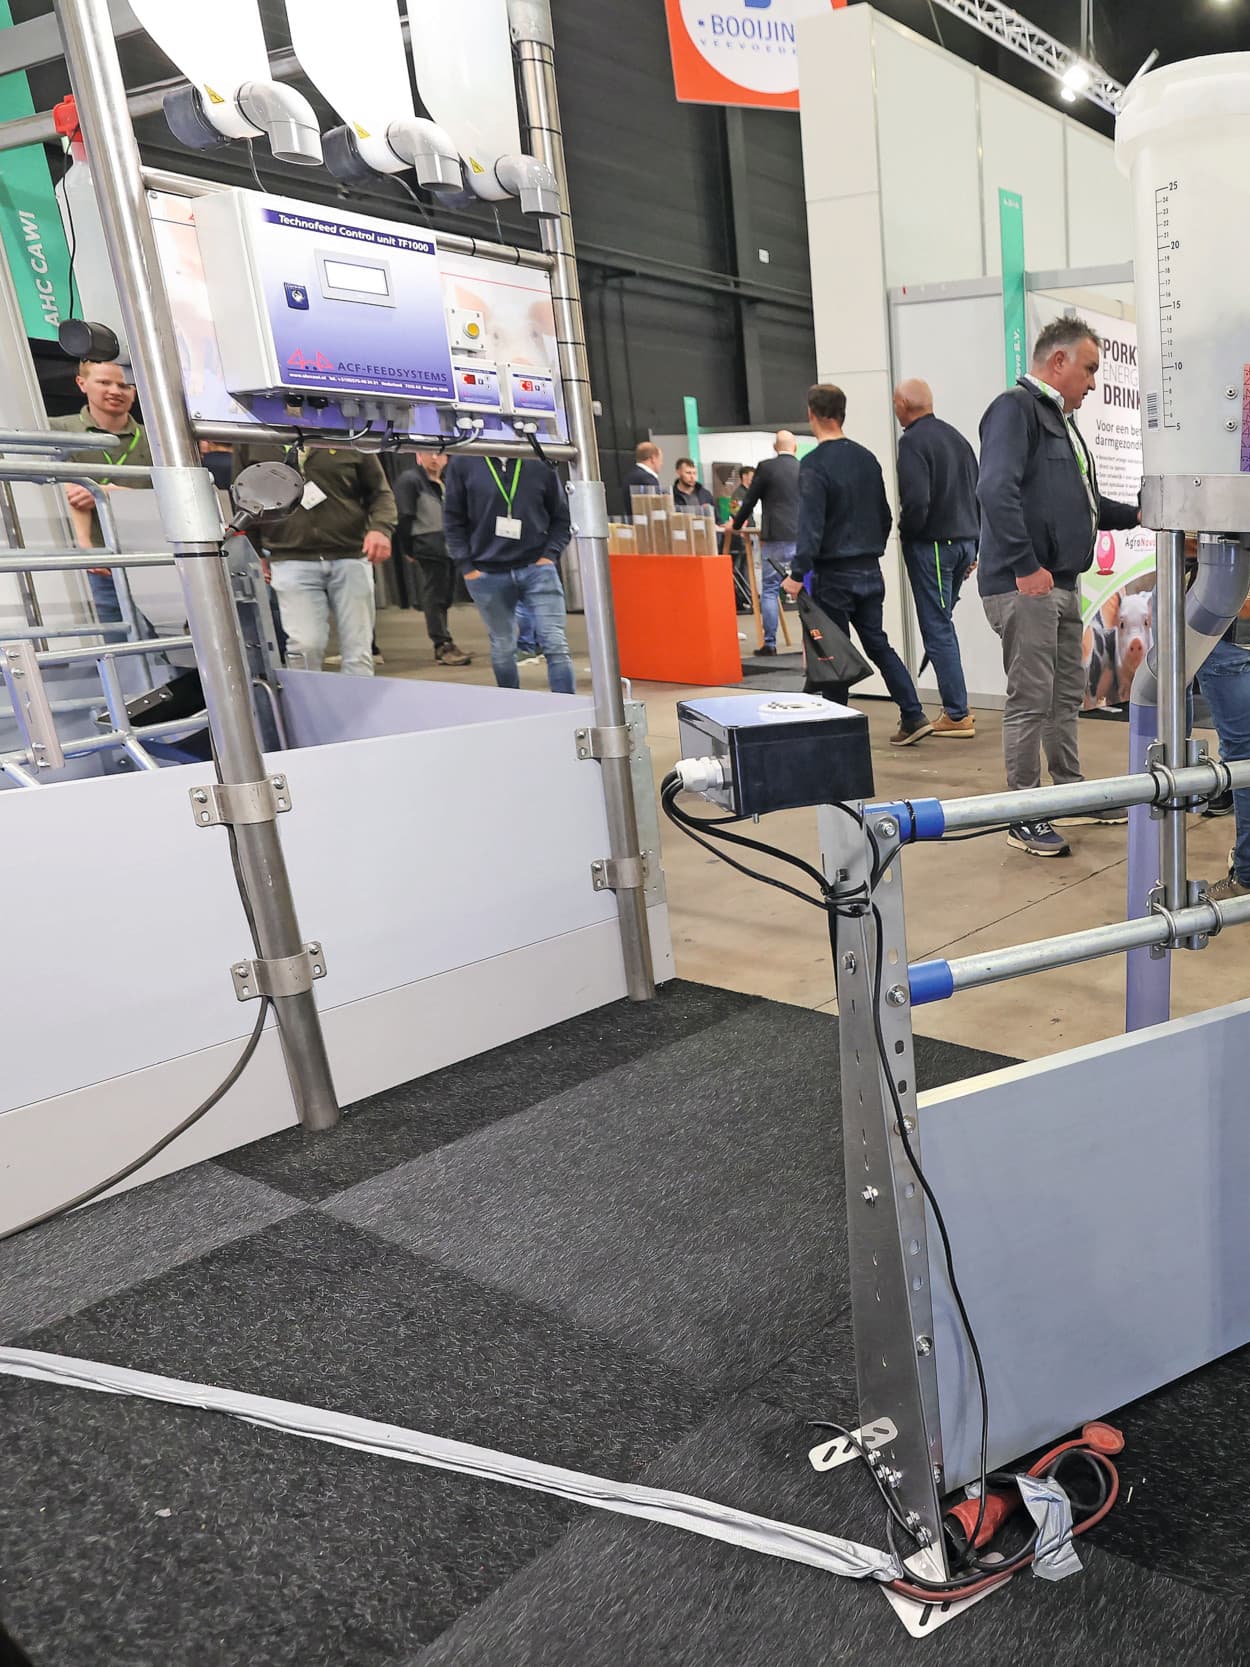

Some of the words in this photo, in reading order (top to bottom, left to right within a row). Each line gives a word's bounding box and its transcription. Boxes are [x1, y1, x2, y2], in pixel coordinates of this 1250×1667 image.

[711, 14, 796, 42] BOOIJIN
[1169, 181, 1178, 191] 25
[19, 210, 49, 274] CAWI
[339, 227, 376, 242] Control
[377, 236, 396, 246] unit
[398, 239, 429, 252] TF1000
[1170, 240, 1180, 250] 20
[36, 279, 60, 328] AHC
[1172, 300, 1181, 309] 15
[337, 362, 448, 382] ACF-FEEDSYSTEMS
[1103, 361, 1138, 387] ENERG
[1174, 361, 1183, 371] 10
[1096, 419, 1114, 433] Voor
[1116, 424, 1129, 435] een
